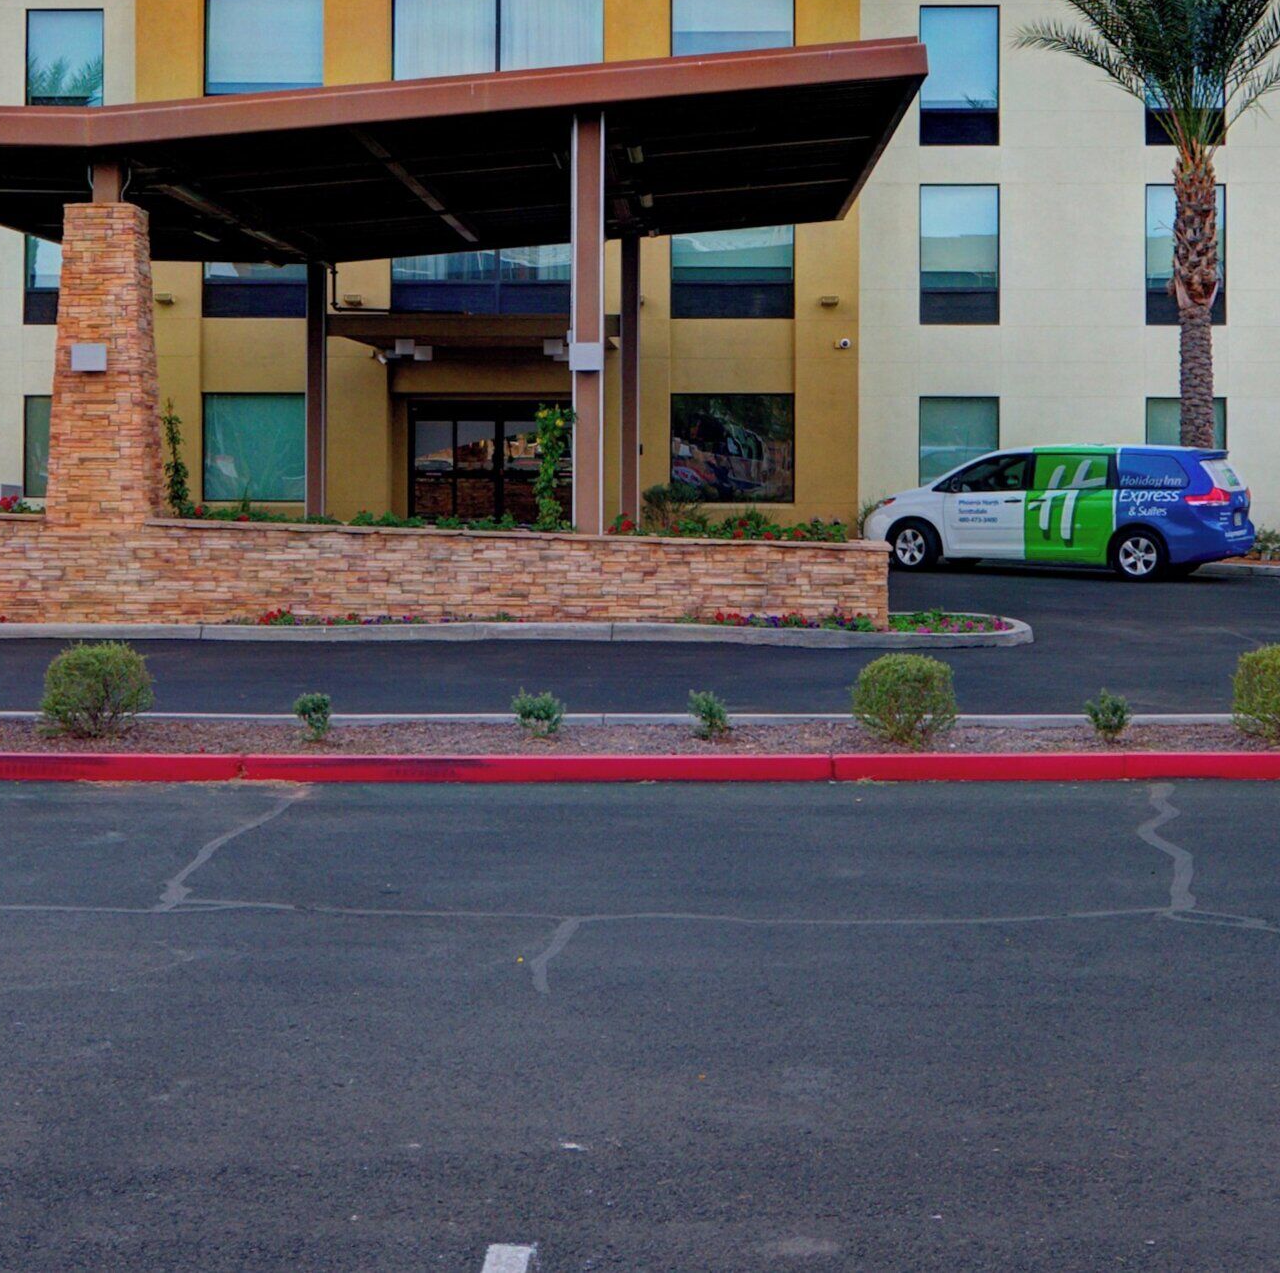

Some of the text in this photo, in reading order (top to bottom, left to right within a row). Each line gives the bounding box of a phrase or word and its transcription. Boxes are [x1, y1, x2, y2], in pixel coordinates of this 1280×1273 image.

[1120, 475, 1182, 487] Holiday Inn
[1119, 489, 1180, 506] Express
[1128, 506, 1167, 517] & Suites
